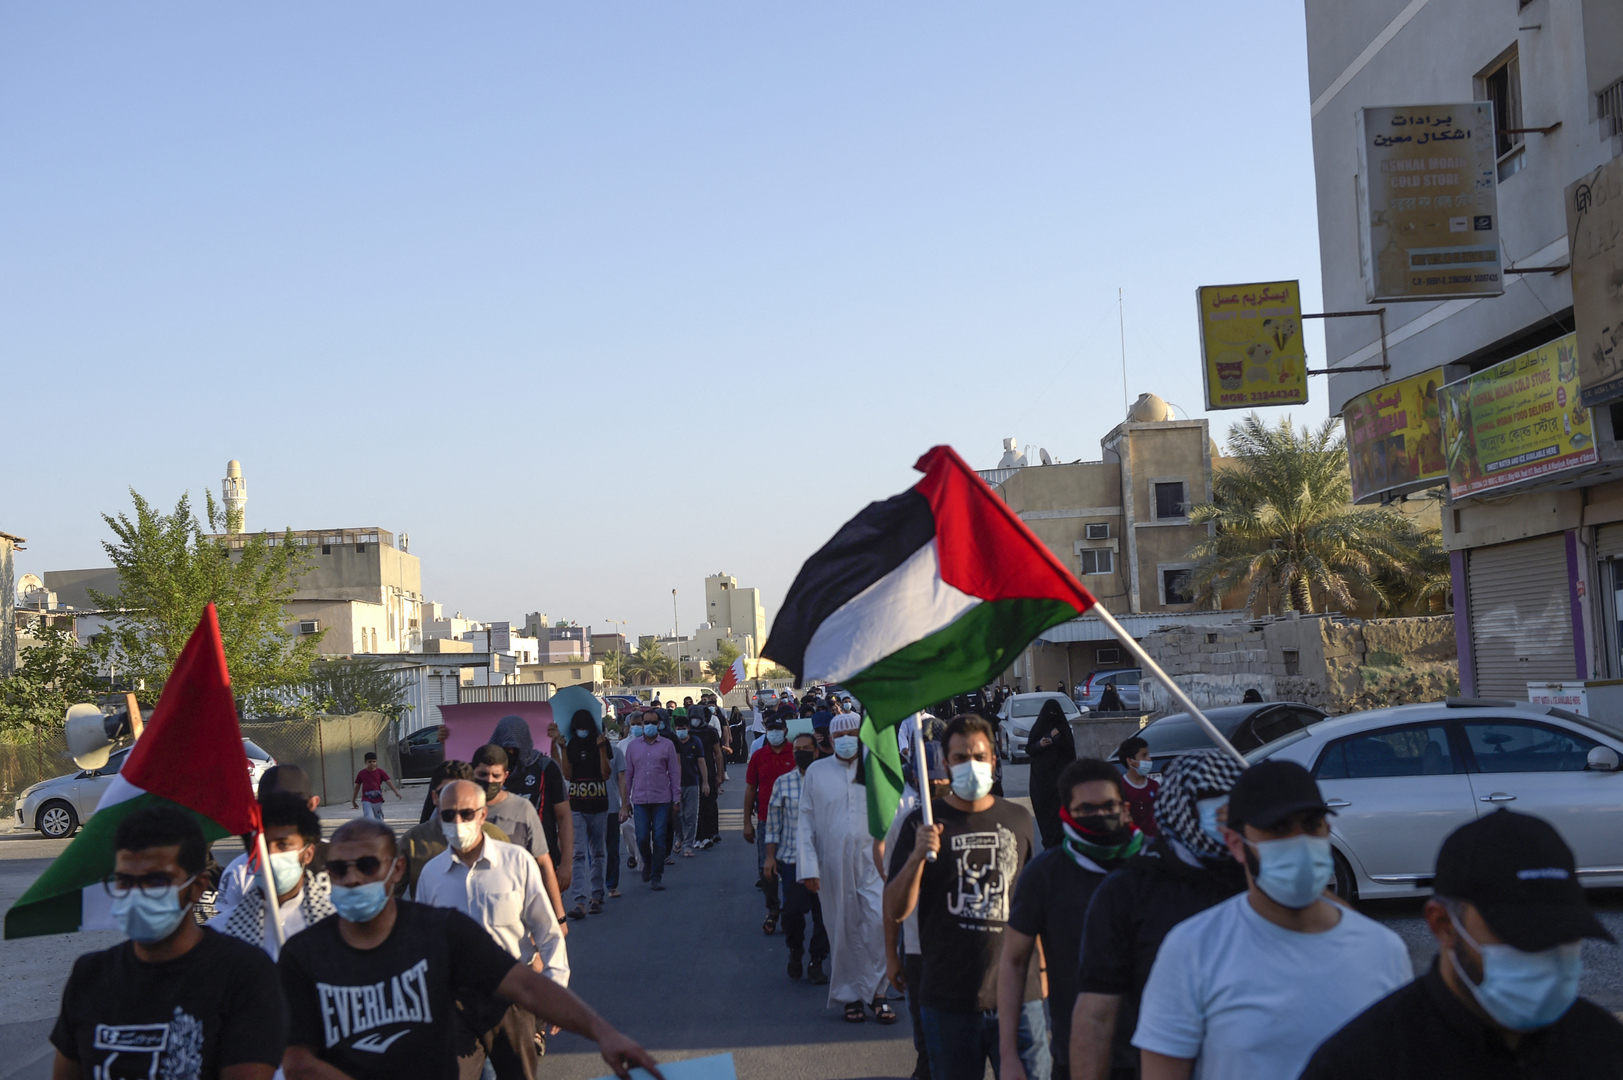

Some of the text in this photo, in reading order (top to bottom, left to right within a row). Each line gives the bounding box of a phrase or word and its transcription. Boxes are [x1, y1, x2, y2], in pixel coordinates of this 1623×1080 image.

[1391, 115, 1452, 126] برادات
[1374, 134, 1412, 147] معين
[1417, 129, 1471, 145] اشكال
[1381, 158, 1426, 173] ASHKAL
[1390, 173, 1461, 188] COLD STORE
[1240, 310, 1257, 319] ICE
[1259, 306, 1294, 318] CREAM
[1514, 376, 1531, 393] COLD
[1531, 368, 1552, 387] STORE
[1220, 393, 1247, 402] MOB:
[1513, 409, 1528, 422] FOOD
[1528, 400, 1555, 417] DELIVERY
[1377, 410, 1408, 436] CREAM
[1546, 445, 1558, 456] HERE
[569, 781, 606, 797] BISON
[316, 958, 433, 1048] EVERLAST
